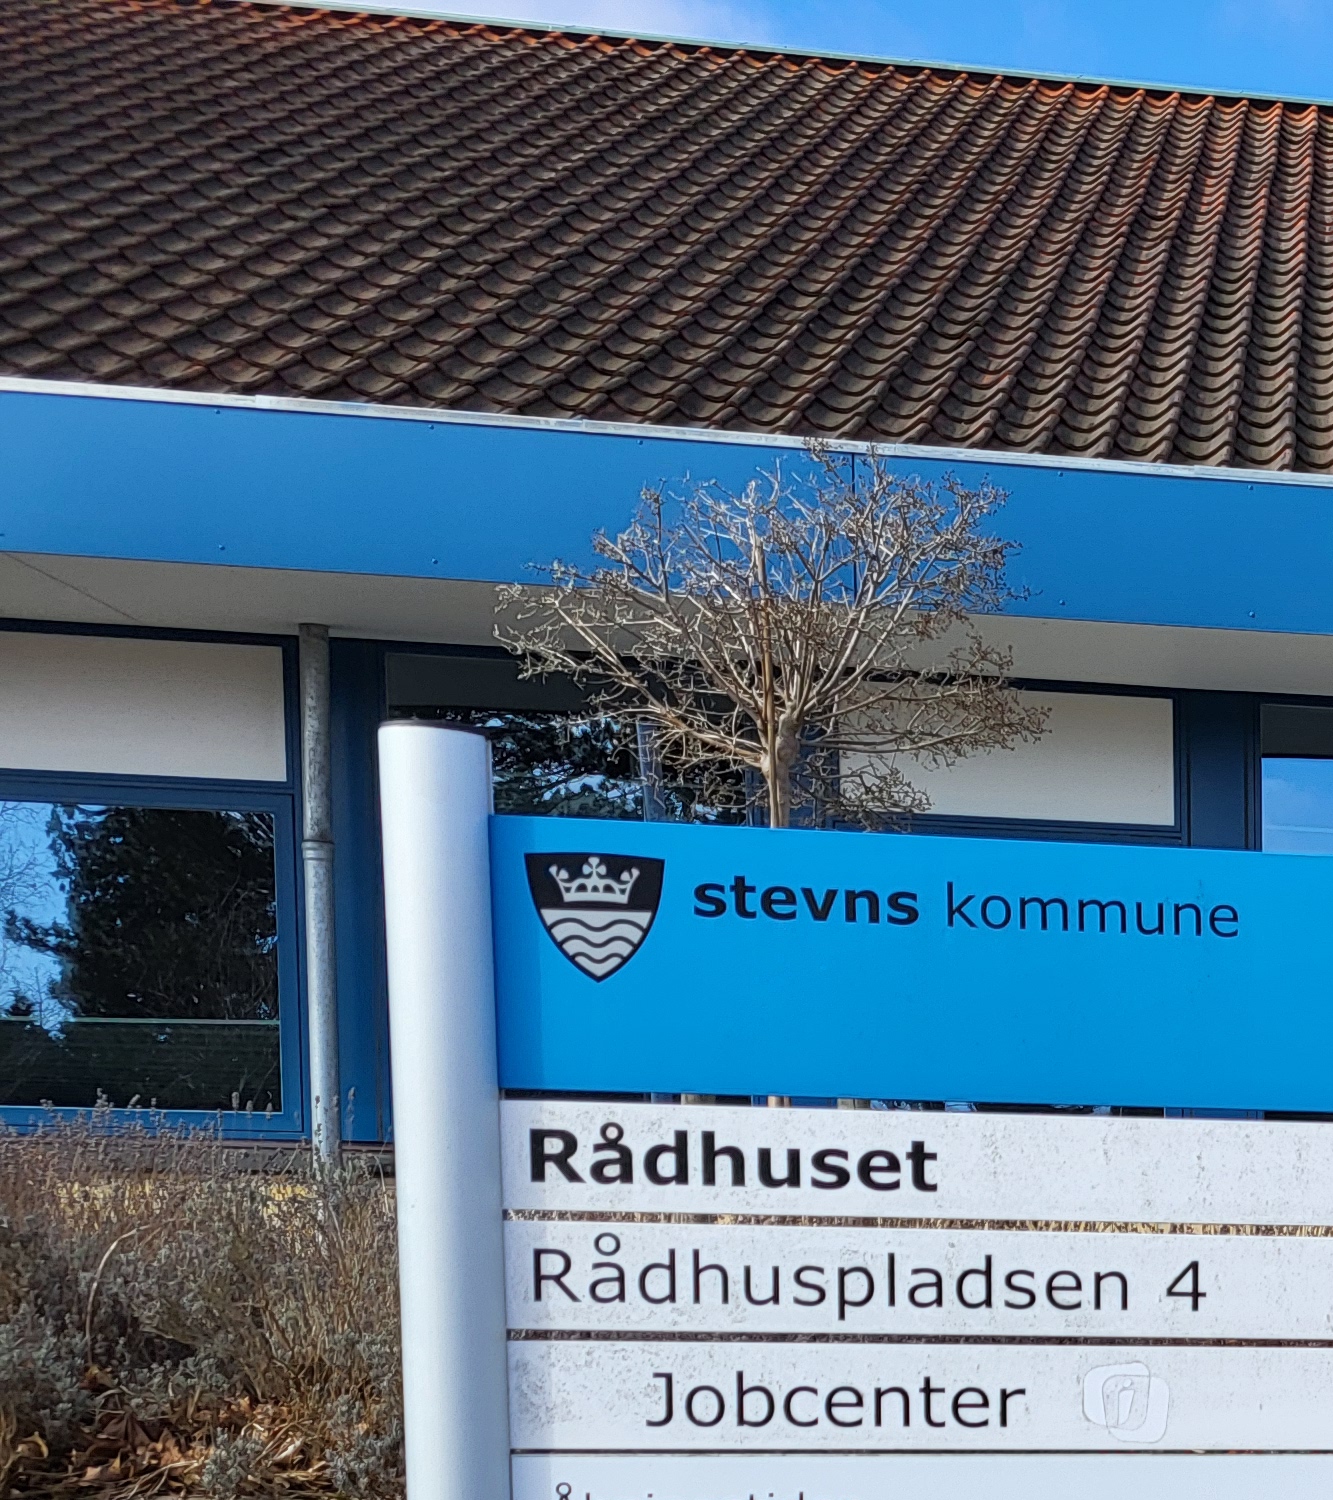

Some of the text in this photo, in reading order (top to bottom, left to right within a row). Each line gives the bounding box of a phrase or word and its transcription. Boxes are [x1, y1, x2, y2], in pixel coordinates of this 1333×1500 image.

[693, 875, 1239, 938] stevns kommune
[529, 1121, 938, 1193] Rådhuset
[532, 1231, 1208, 1320] Rådhuspladsen 4
[646, 1370, 1026, 1429] Jobcenter
